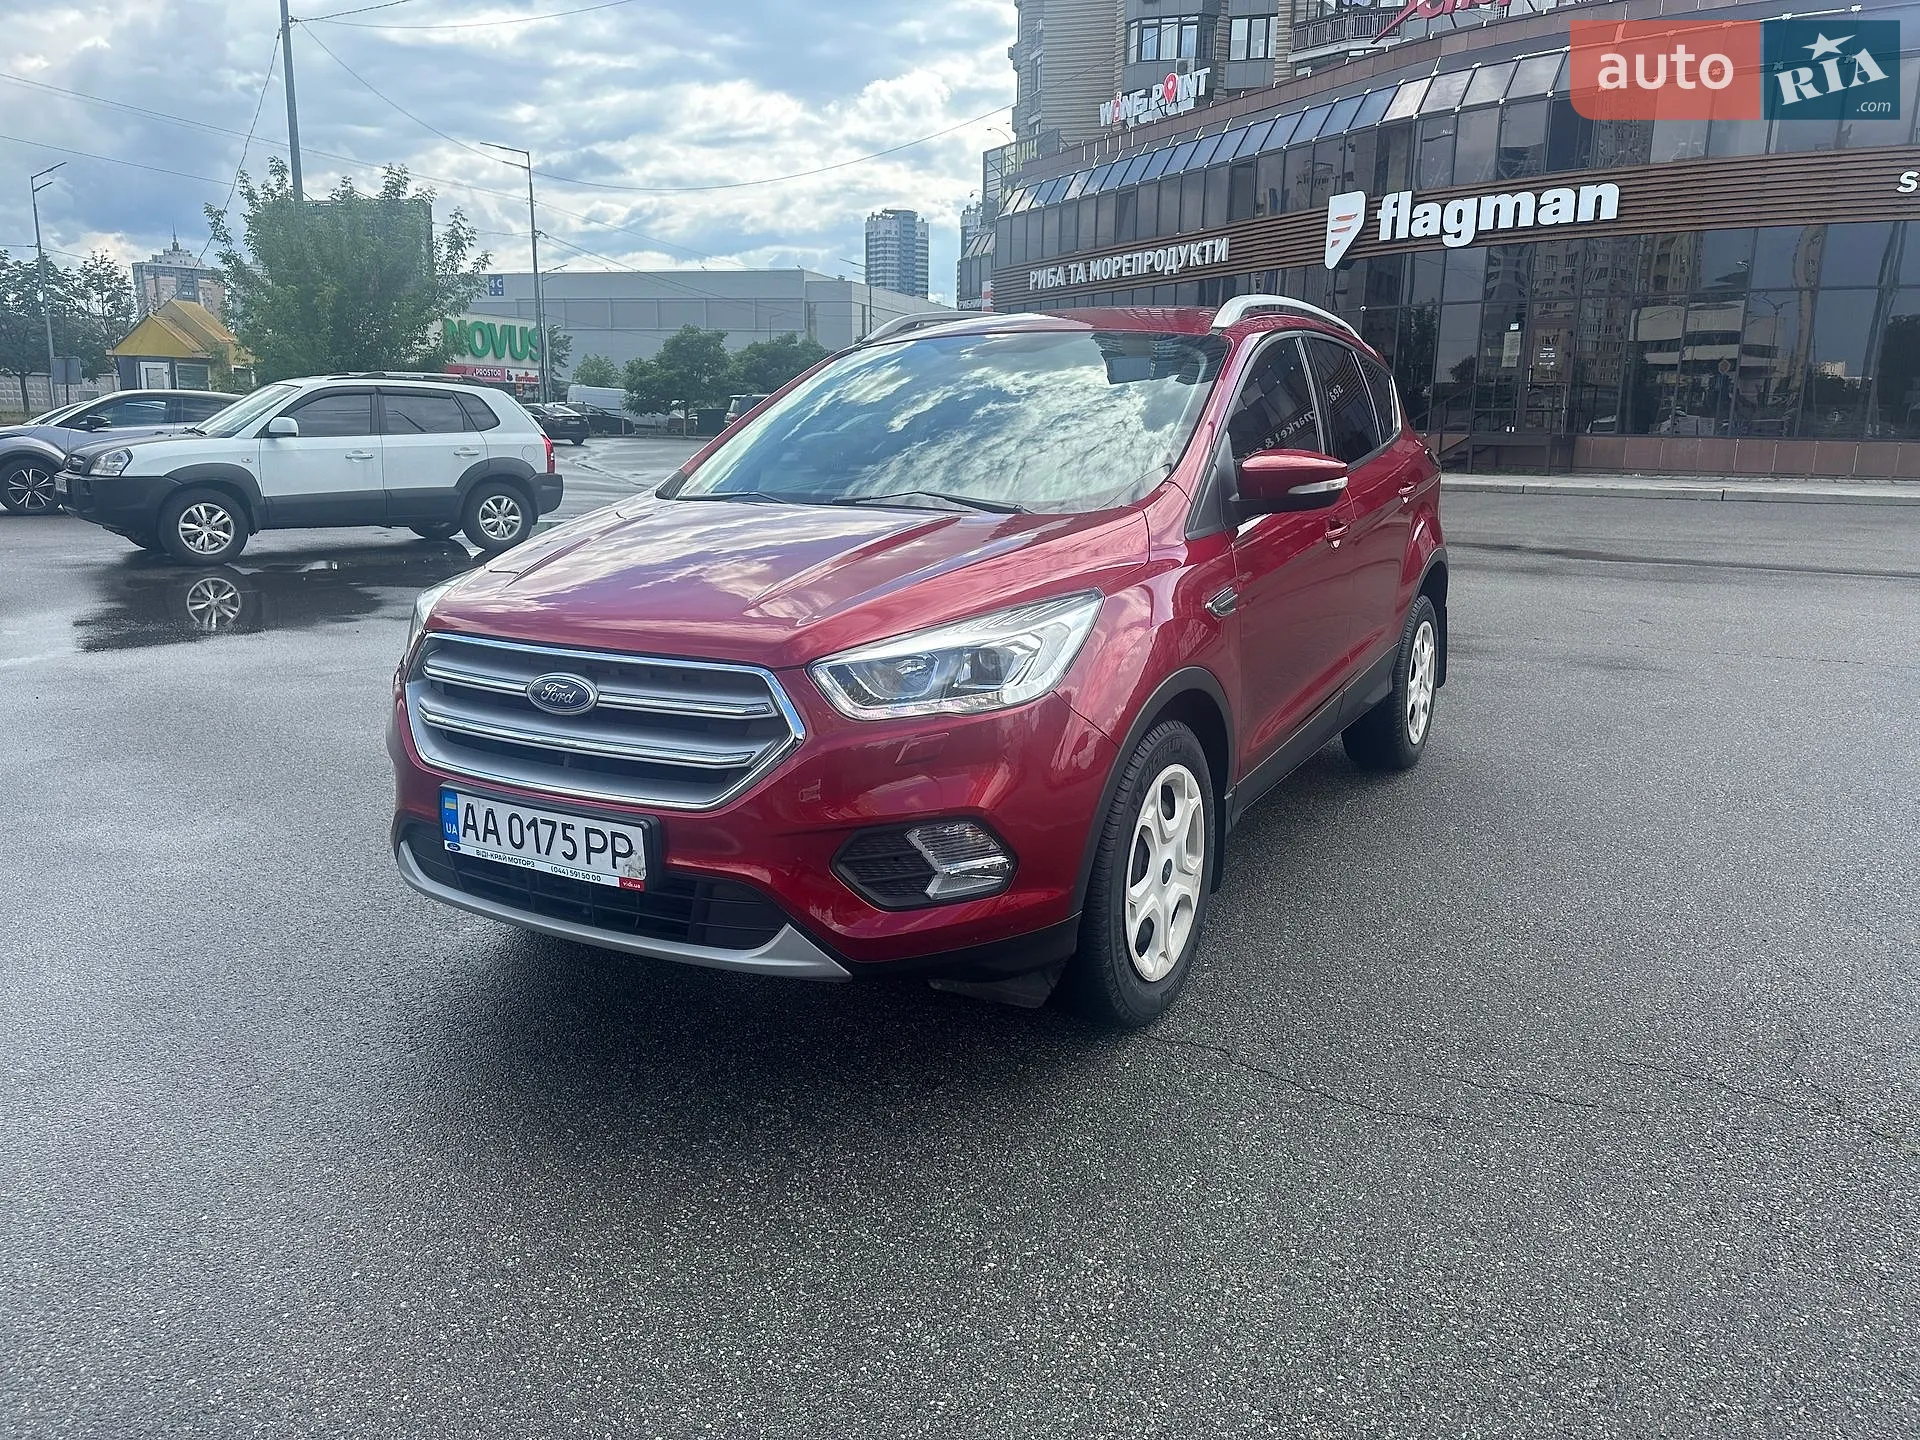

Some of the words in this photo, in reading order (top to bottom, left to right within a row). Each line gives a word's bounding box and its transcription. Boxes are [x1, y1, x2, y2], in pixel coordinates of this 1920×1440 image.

[1377, 183, 1620, 248] flagman
[1029, 265, 1067, 291] РИБА
[1068, 262, 1088, 285] ТА
[1089, 237, 1230, 282] МОРЕПРОДУКТИ
[475, 368, 501, 377] PROSTOR
[541, 682, 577, 704] Ford
[445, 822, 458, 835] UA
[462, 802, 502, 847] AA
[507, 812, 577, 861] 0175
[584, 826, 634, 870] PP
[569, 870, 581, 878] 591
